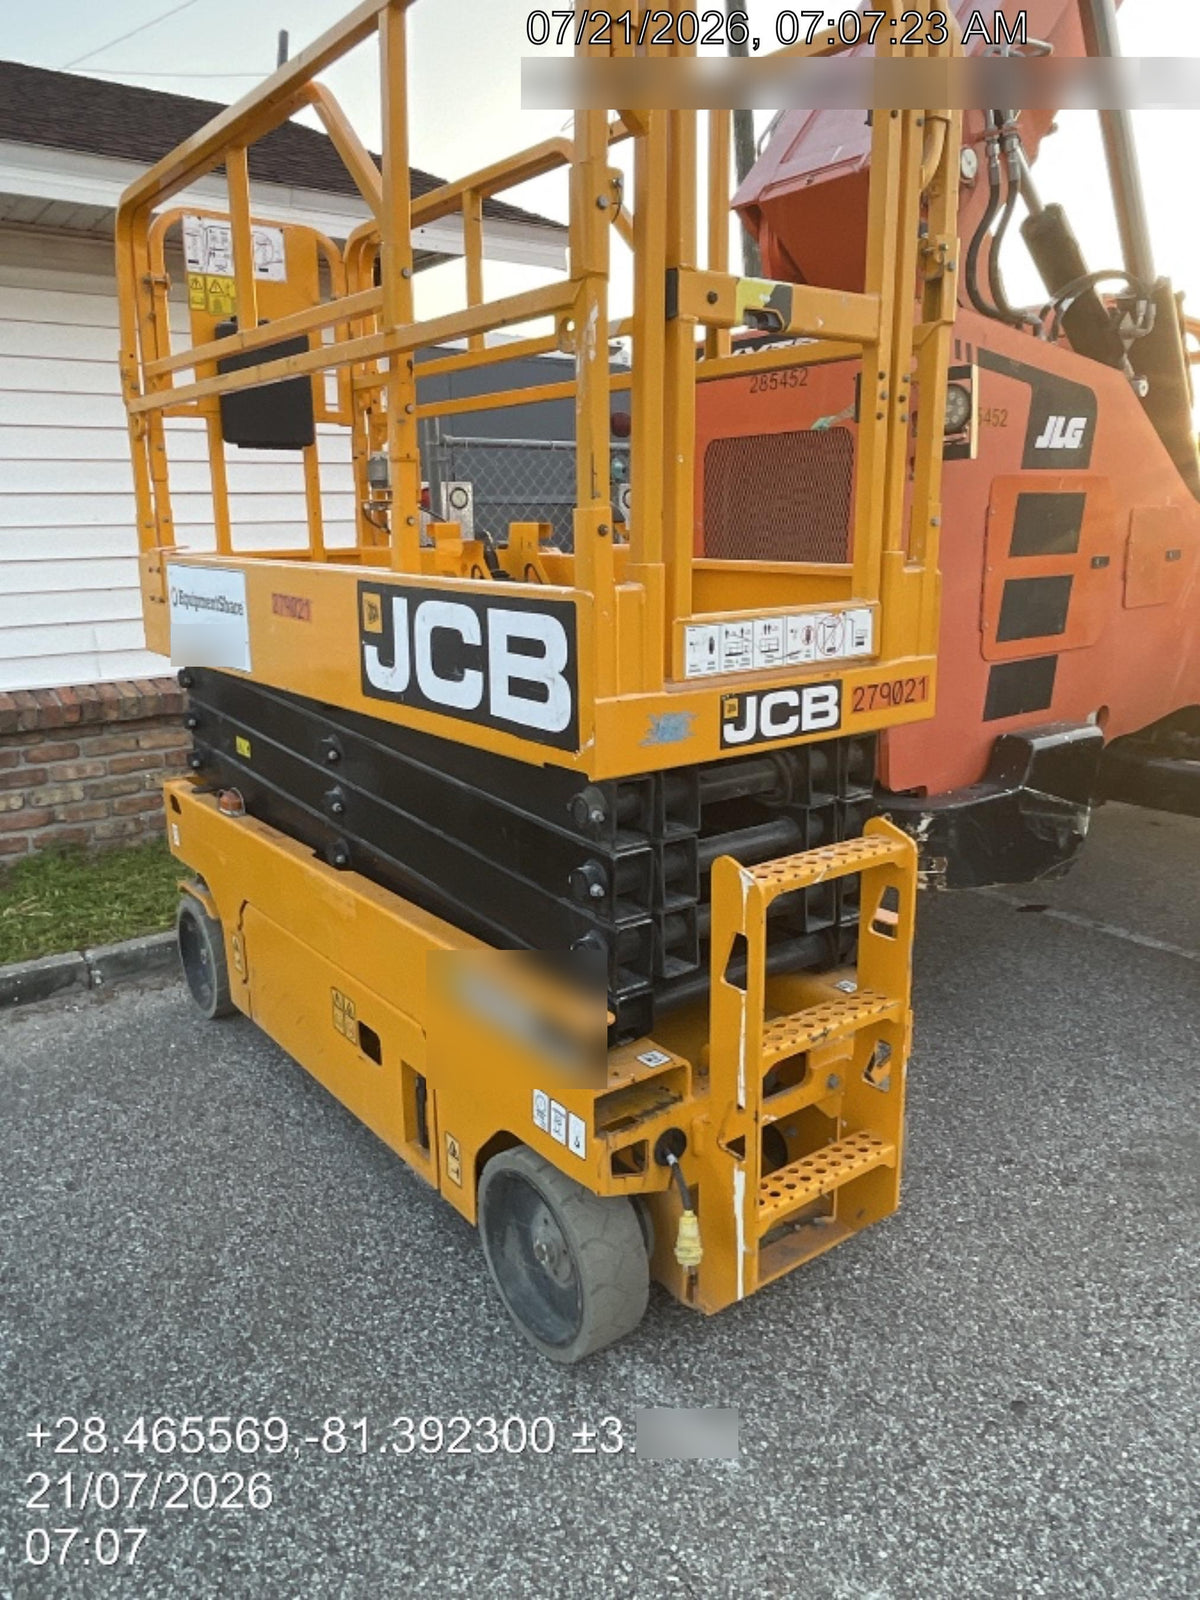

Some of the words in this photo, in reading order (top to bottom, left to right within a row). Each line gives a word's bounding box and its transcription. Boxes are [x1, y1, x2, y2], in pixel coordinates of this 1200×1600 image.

[749, 368, 808, 394] 285452
[1034, 415, 1087, 449] JLG
[362, 596, 572, 733] JCB
[852, 677, 928, 713] 279021
[723, 685, 840, 744] JCB
